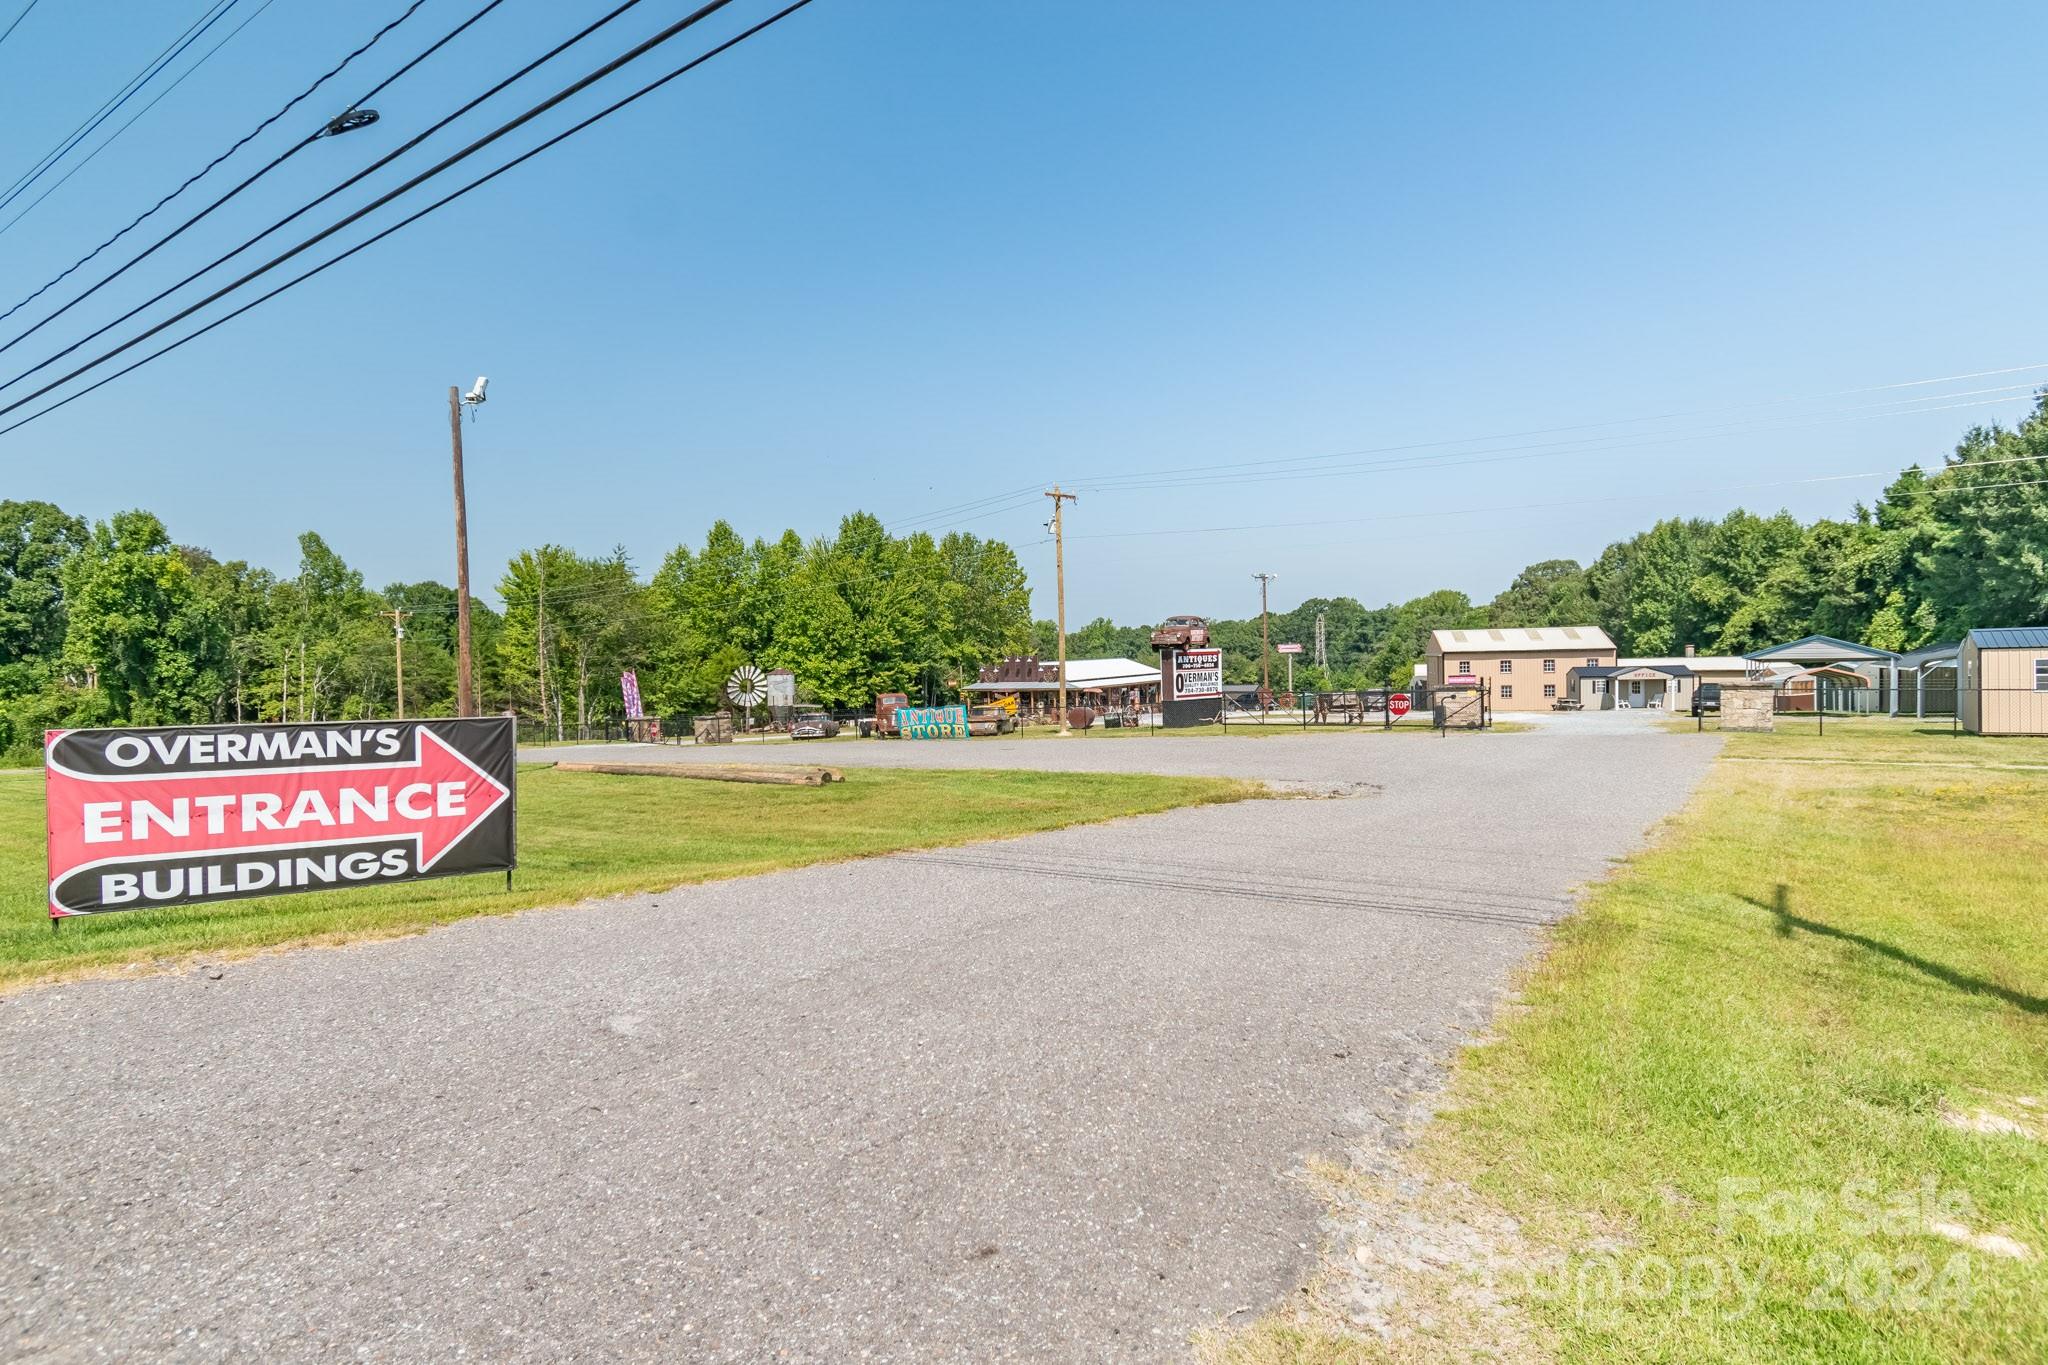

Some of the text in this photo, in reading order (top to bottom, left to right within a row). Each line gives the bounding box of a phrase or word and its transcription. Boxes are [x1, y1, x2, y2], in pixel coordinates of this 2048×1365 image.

[1178, 655, 1218, 664] ANTIQUES
[1176, 672, 1219, 693] OVERMAN'S
[1389, 700, 1410, 709] STOP
[901, 707, 964, 726] ANTIQUE
[901, 724, 966, 740] STORE
[105, 728, 401, 767] OVERMAN'S
[83, 781, 467, 843] ENTRANCE
[101, 849, 409, 904] BUILDINGS
